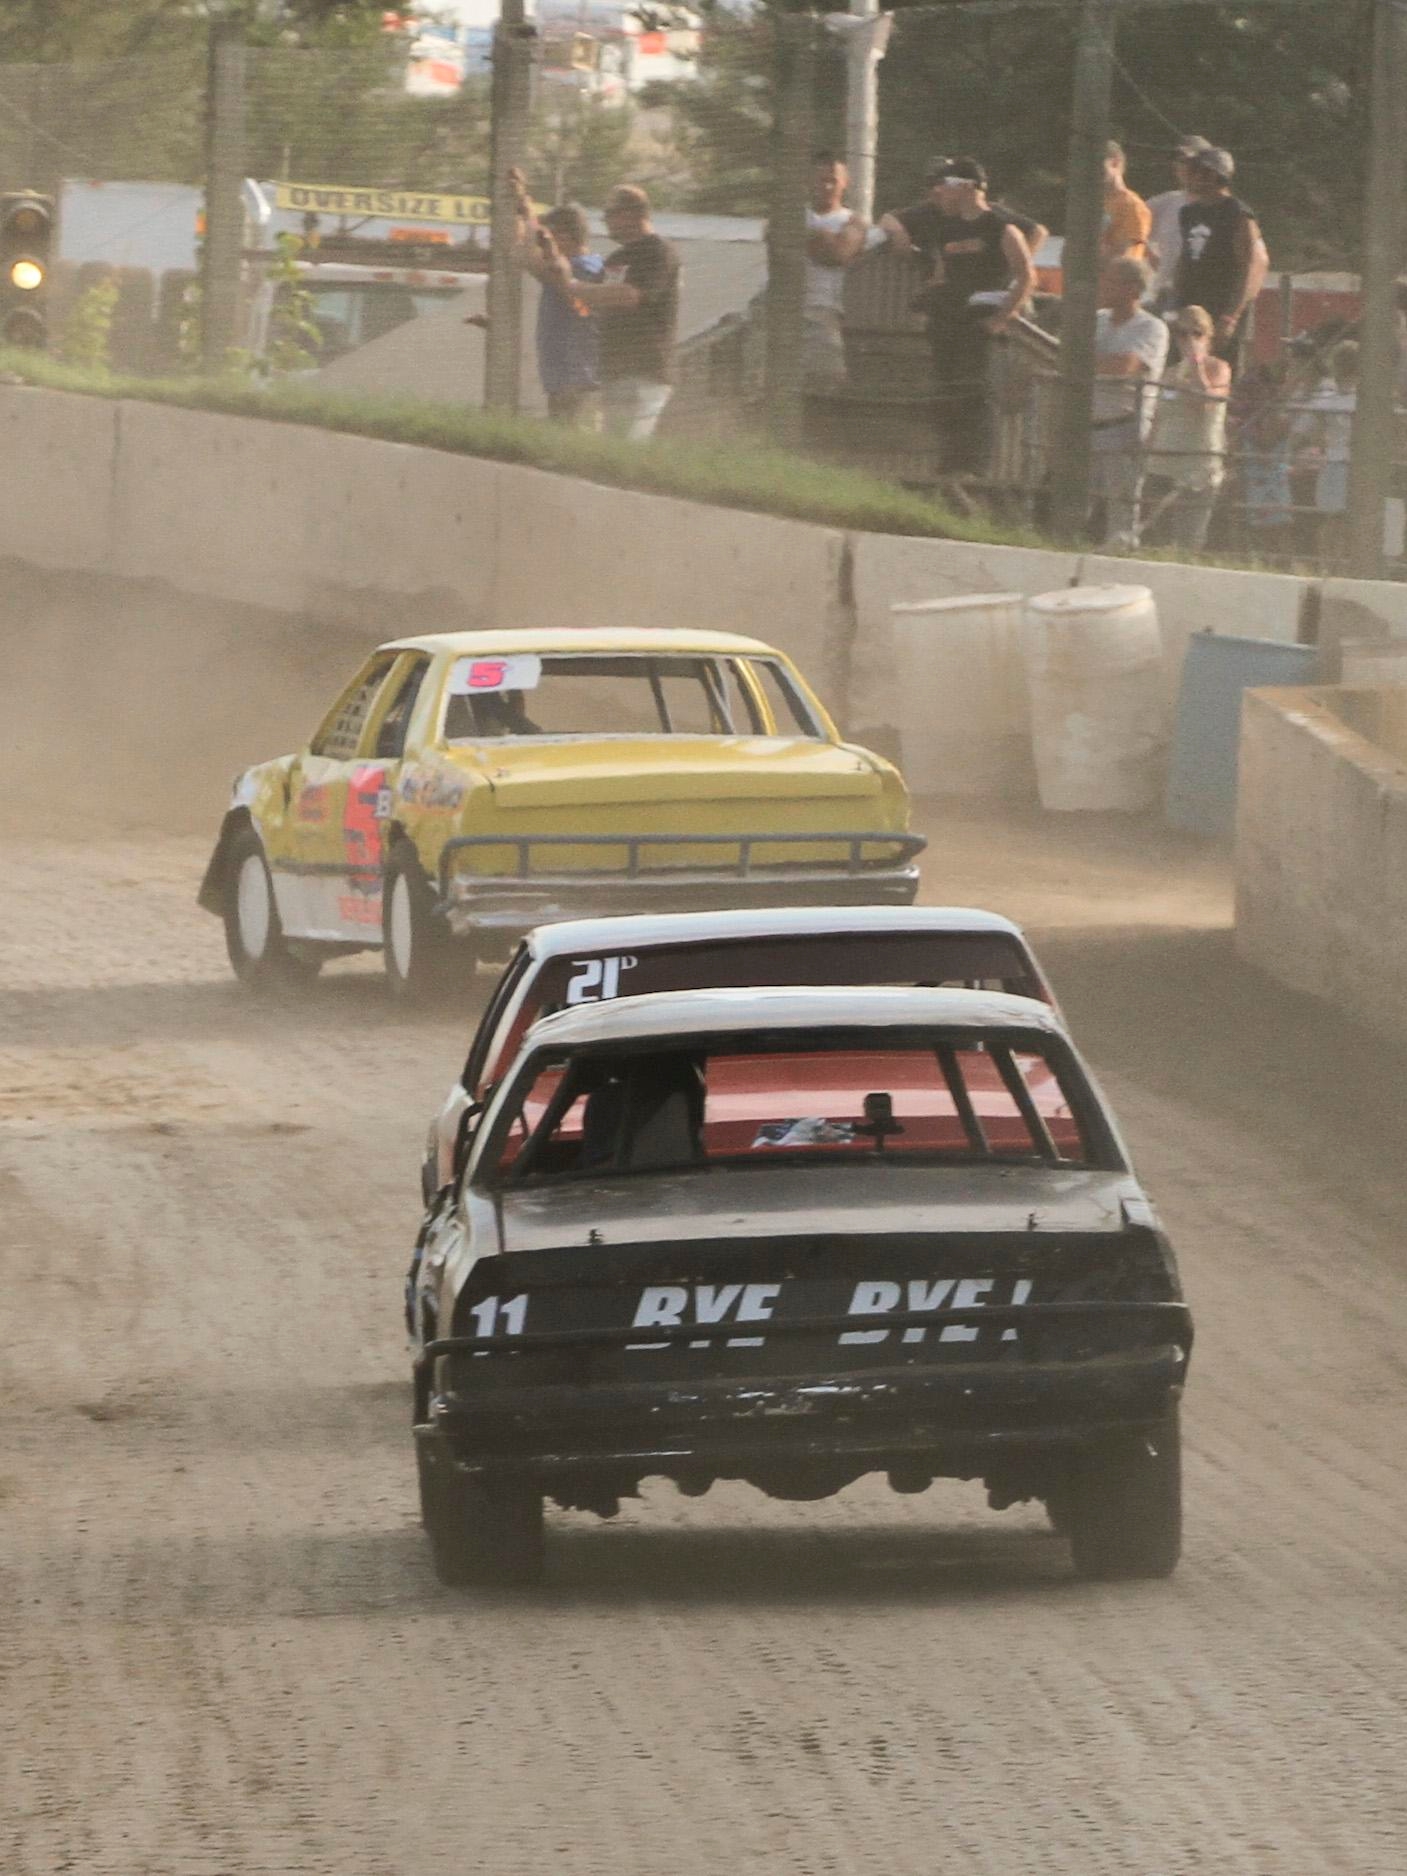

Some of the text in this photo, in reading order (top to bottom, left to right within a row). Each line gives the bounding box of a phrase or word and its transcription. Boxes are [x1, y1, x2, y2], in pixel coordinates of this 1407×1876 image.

[289, 189, 491, 220] OVERSIZE LO
[467, 661, 508, 688] 5
[470, 1294, 528, 1356] 11
